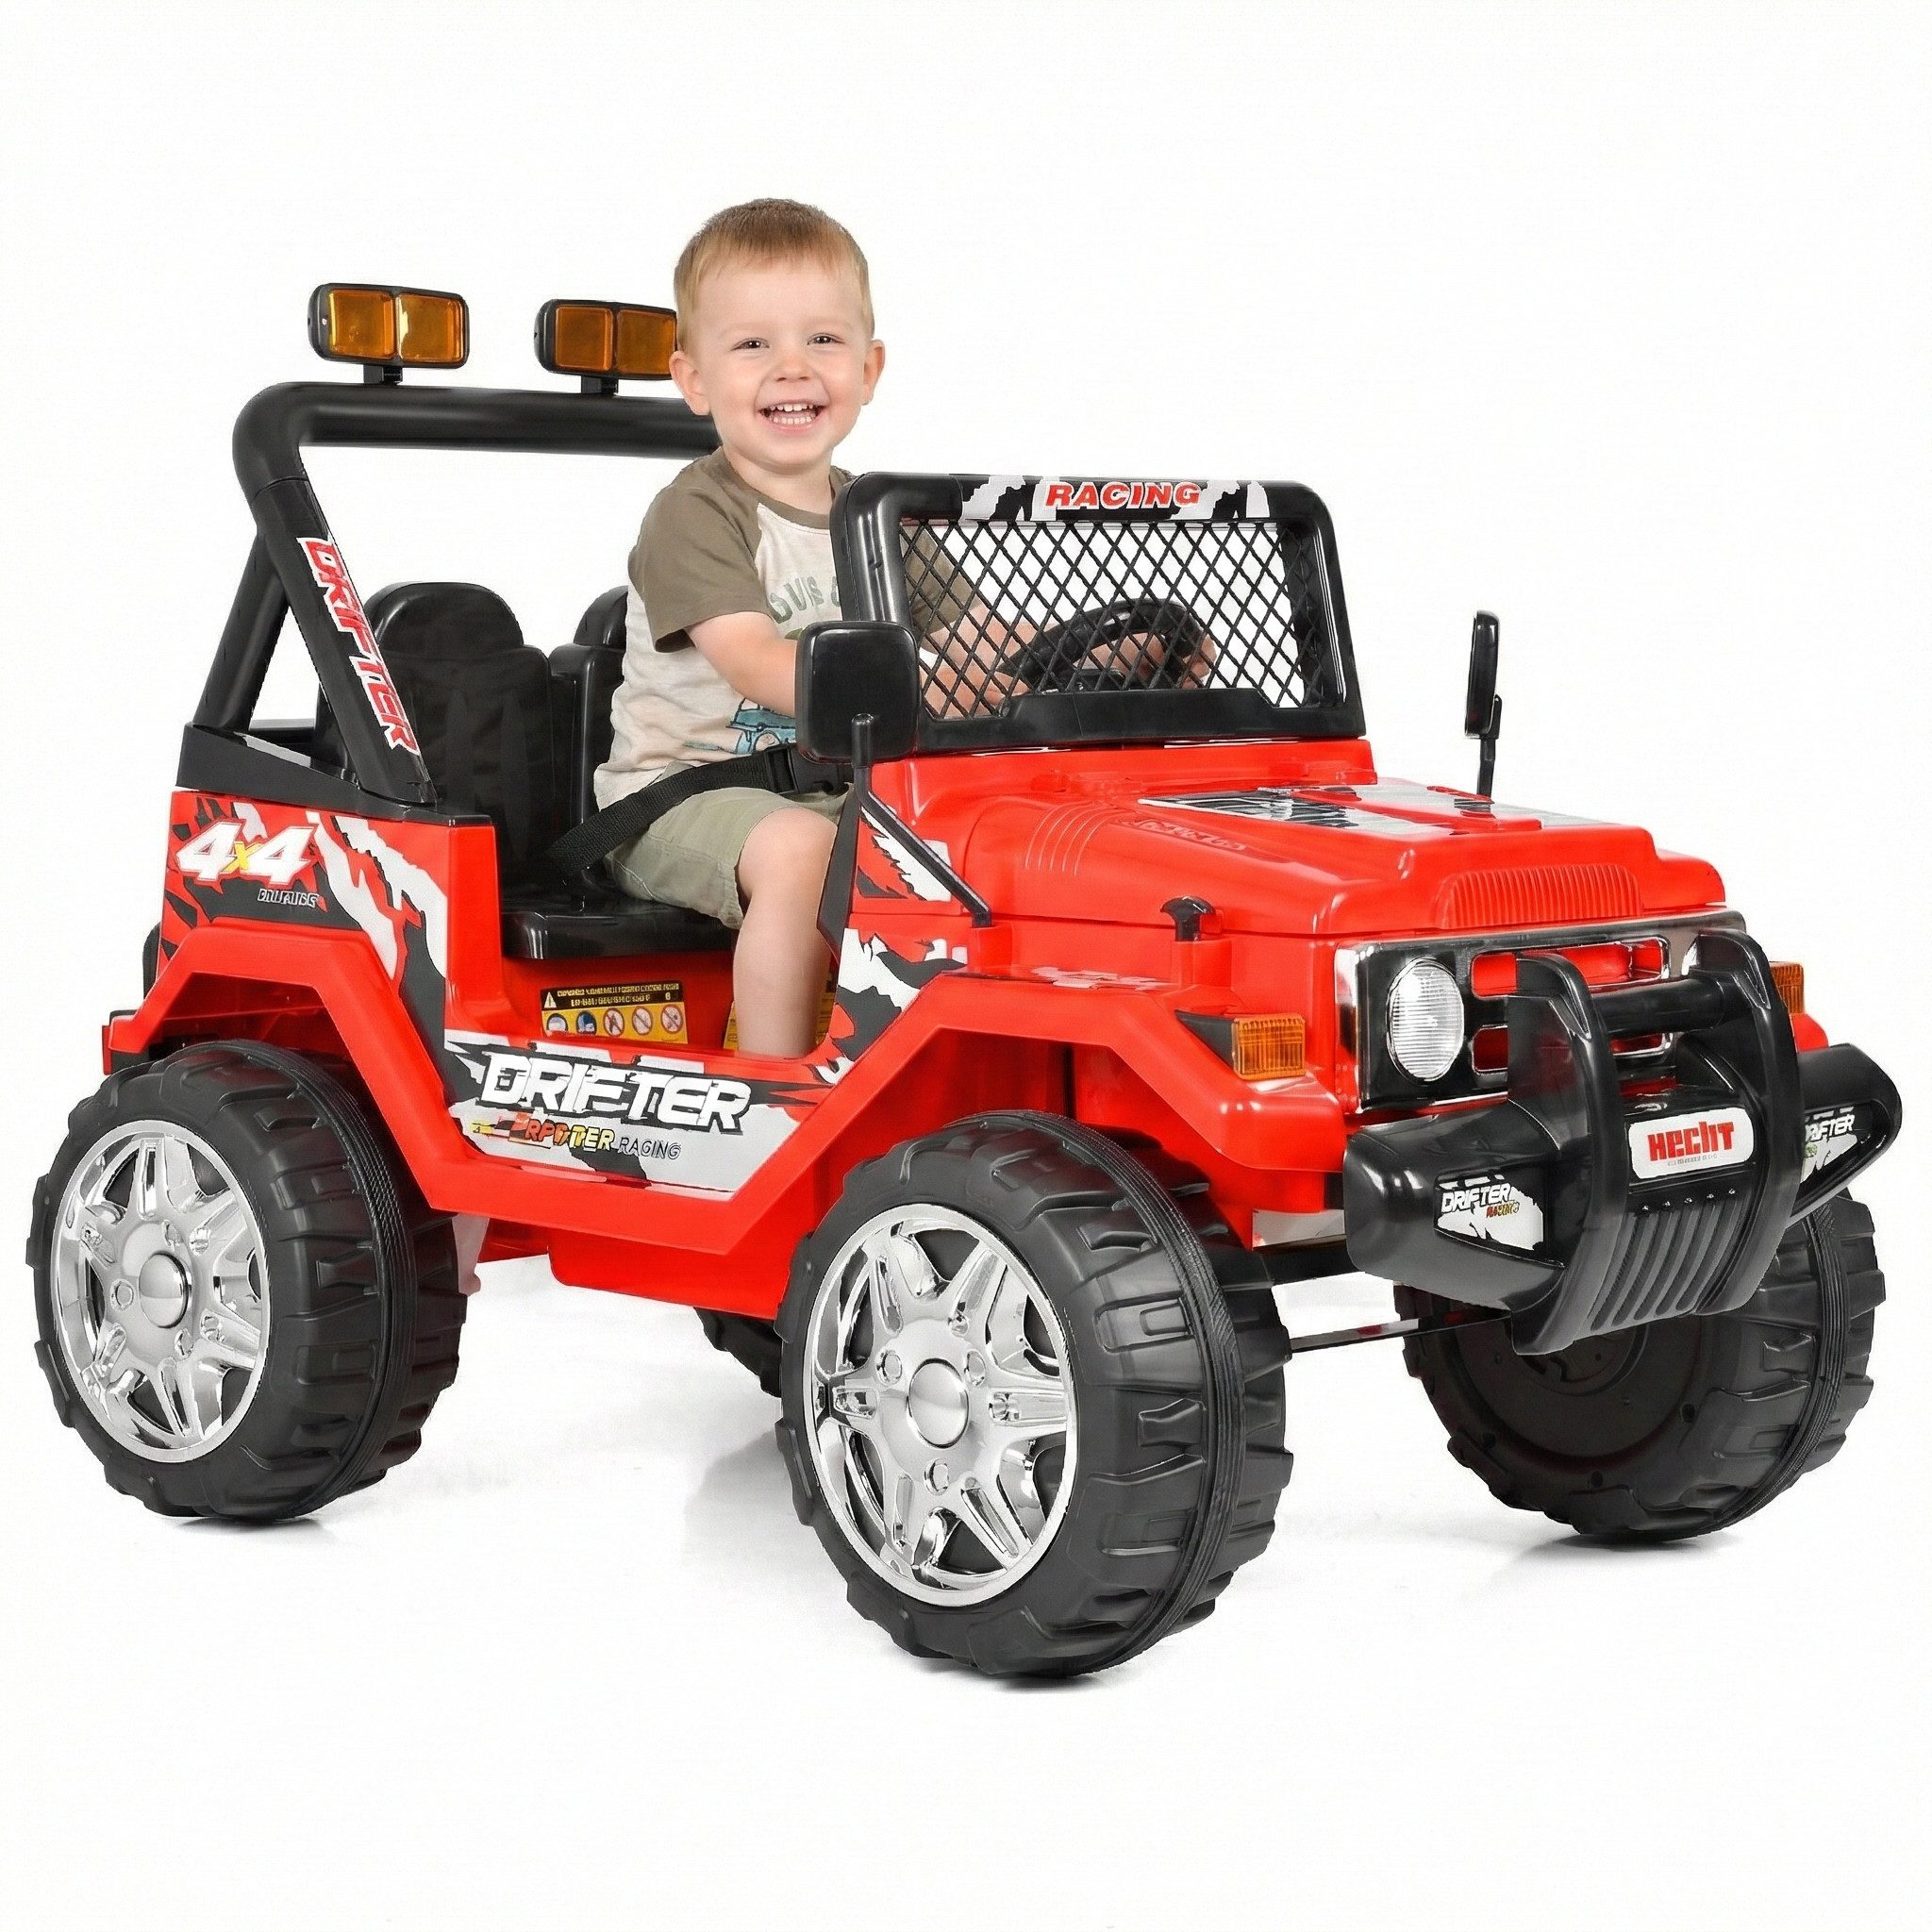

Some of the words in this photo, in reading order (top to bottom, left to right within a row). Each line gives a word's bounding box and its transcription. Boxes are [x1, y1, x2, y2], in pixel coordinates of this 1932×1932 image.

[1044, 483, 1201, 508] RACING
[297, 538, 420, 755] DRIFTER
[480, 1051, 752, 1130] DRIFTER
[1441, 1182, 1511, 1213] DRIFTER
